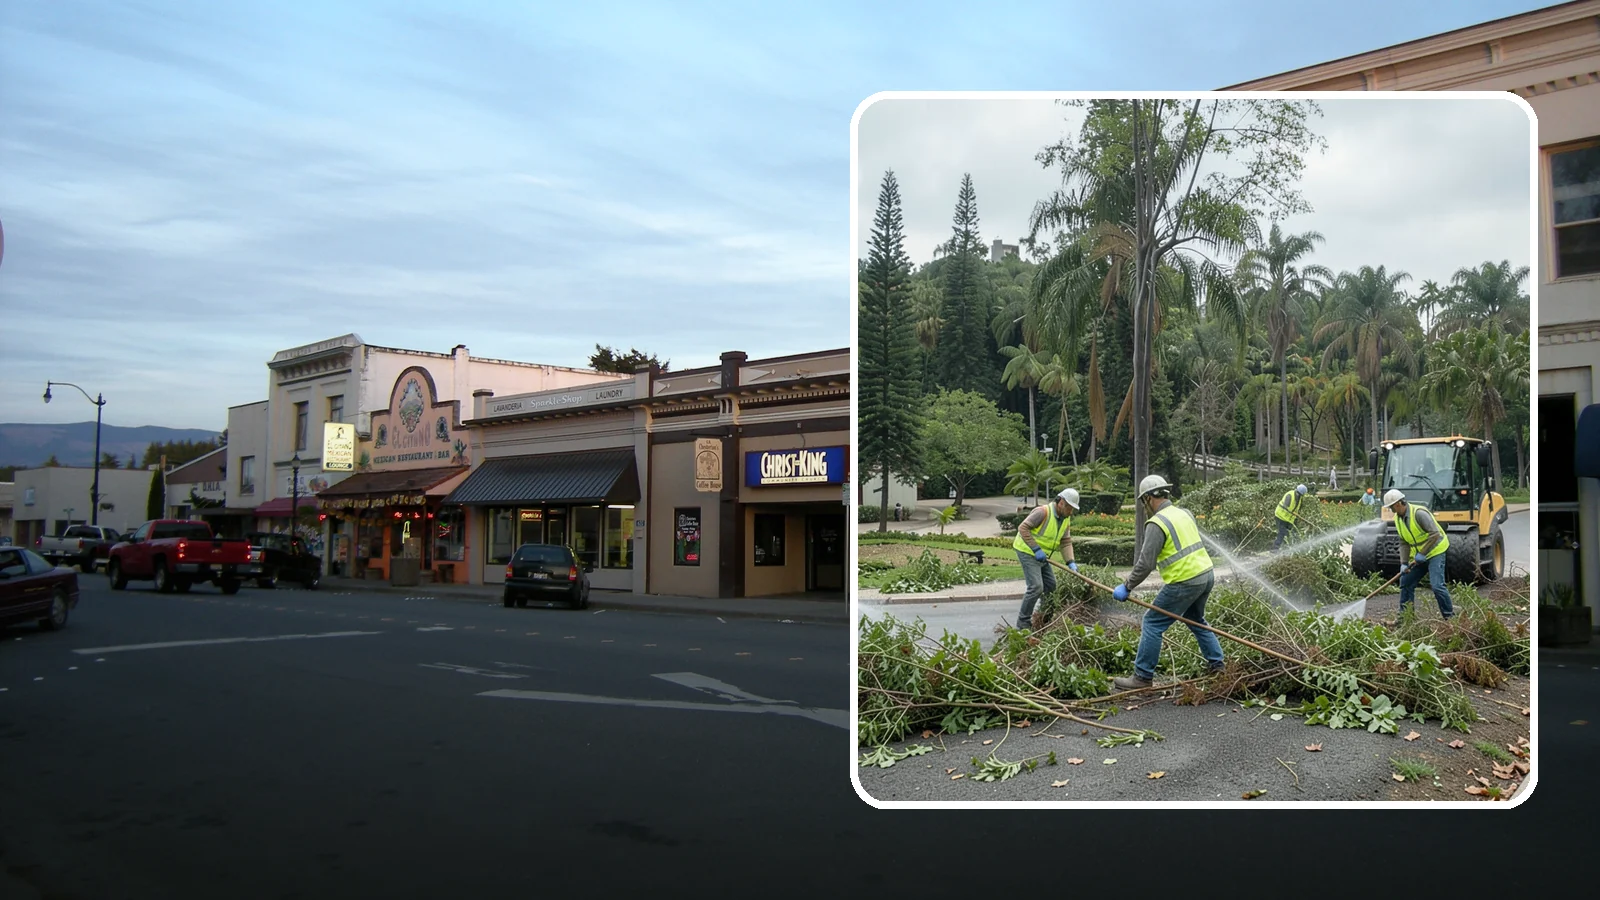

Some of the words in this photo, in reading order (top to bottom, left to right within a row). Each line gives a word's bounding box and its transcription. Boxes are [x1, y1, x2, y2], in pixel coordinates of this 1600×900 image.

[493, 402, 522, 413] LAVANDERIA
[562, 394, 583, 405] Shop
[595, 389, 623, 400] LAUNDRY
[392, 425, 402, 449] EL
[373, 454, 396, 464] MEXICAN
[397, 451, 433, 462] RESTAURANT
[437, 450, 450, 459] BAR
[761, 452, 796, 477] CHRIST
[799, 450, 827, 476] KING
